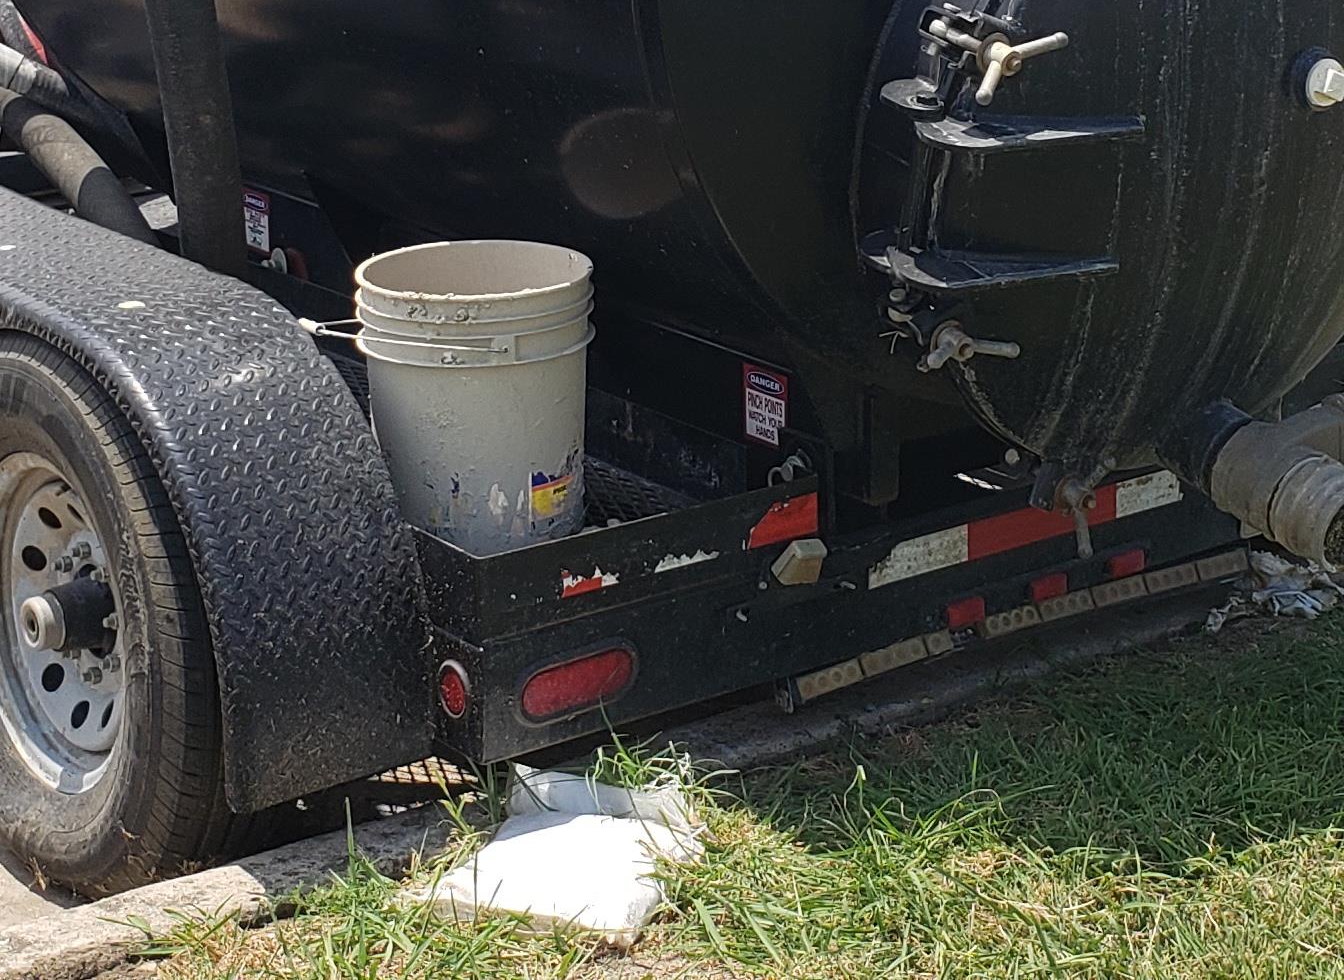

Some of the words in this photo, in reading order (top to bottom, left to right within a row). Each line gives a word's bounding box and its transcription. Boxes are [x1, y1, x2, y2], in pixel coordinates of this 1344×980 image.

[750, 374, 781, 392] DANGER
[747, 391, 765, 413] PINCH
[764, 397, 783, 419] POINTS
[756, 424, 775, 441] HANDS
